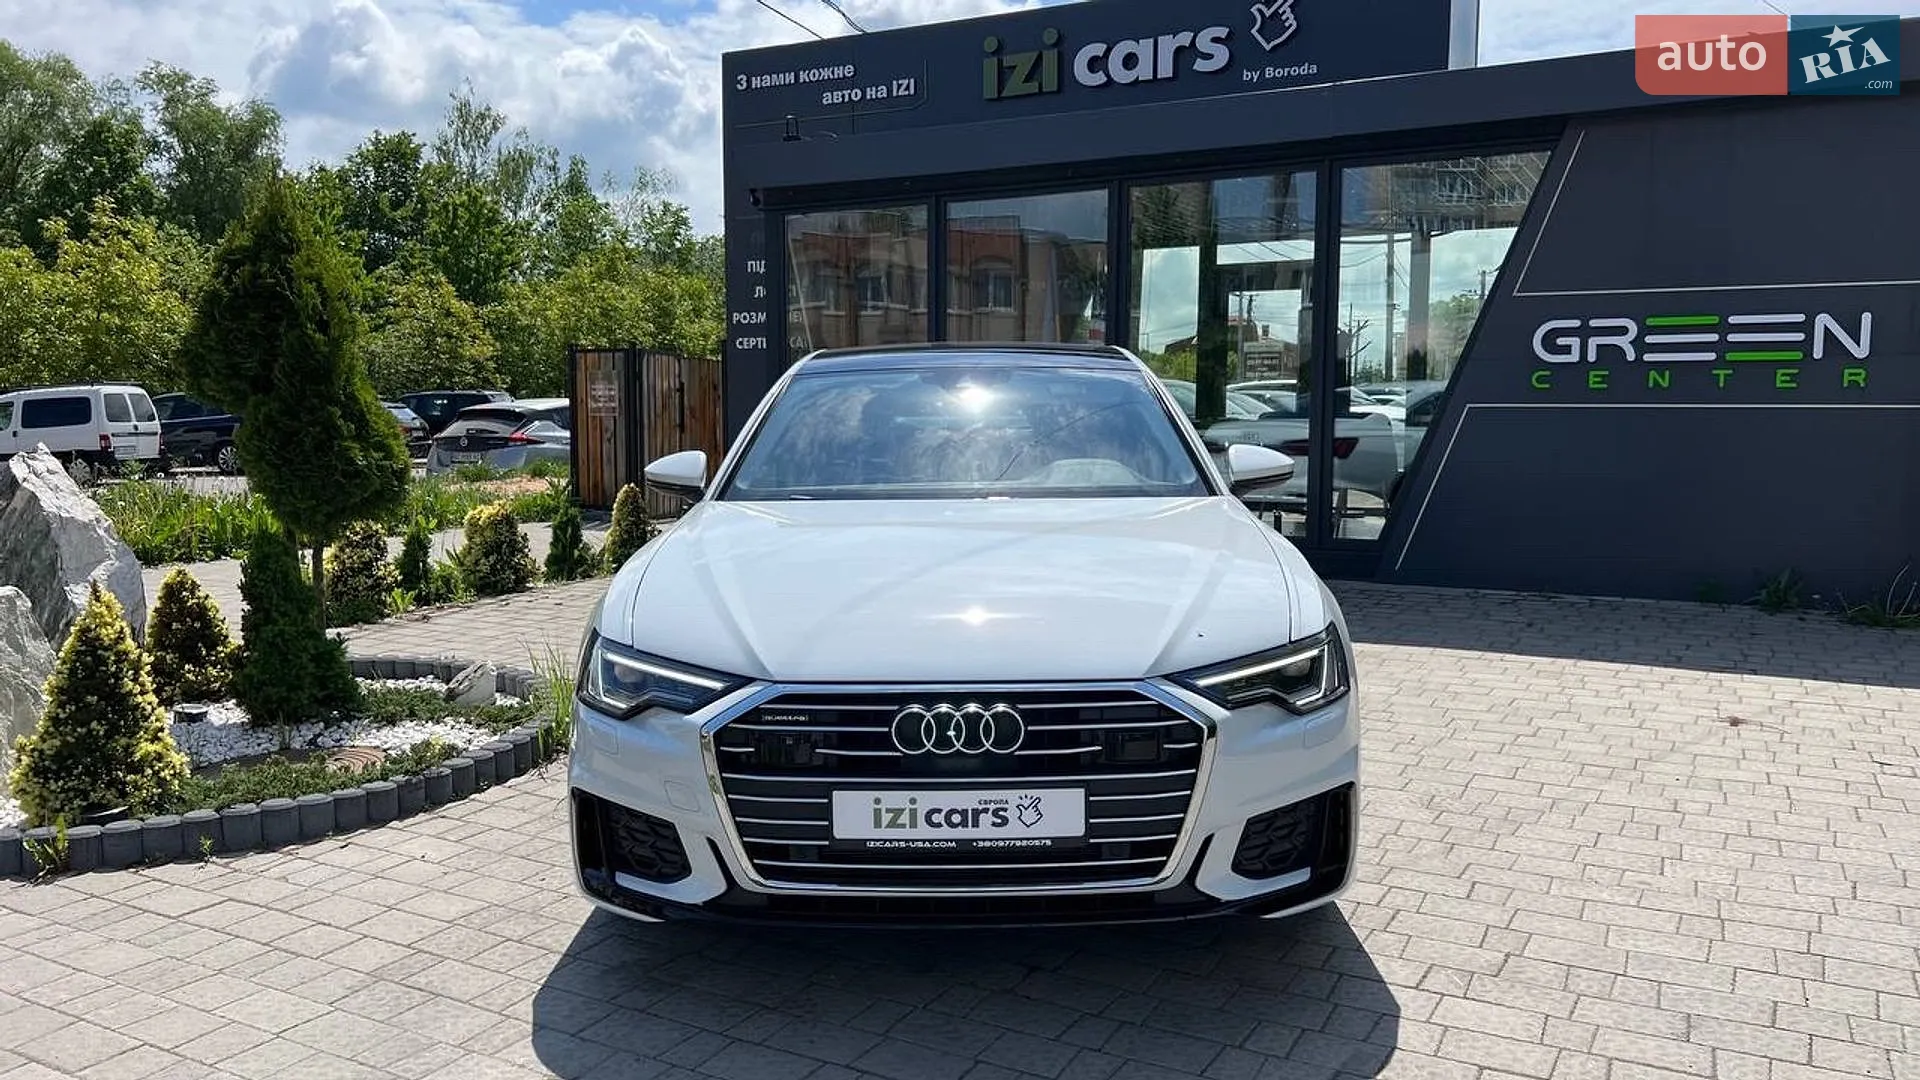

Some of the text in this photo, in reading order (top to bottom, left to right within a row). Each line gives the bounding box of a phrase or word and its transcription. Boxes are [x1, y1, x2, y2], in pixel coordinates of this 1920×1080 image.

[983, 26, 1230, 99] izi cars
[1243, 62, 1317, 81] by Boroda
[751, 71, 795, 89] нами
[799, 64, 855, 83] кожне
[822, 78, 915, 105] авто на IZI
[1532, 311, 1873, 364] GREEN
[1531, 367, 1870, 389] CENTER
[873, 797, 1010, 829] izi cars
